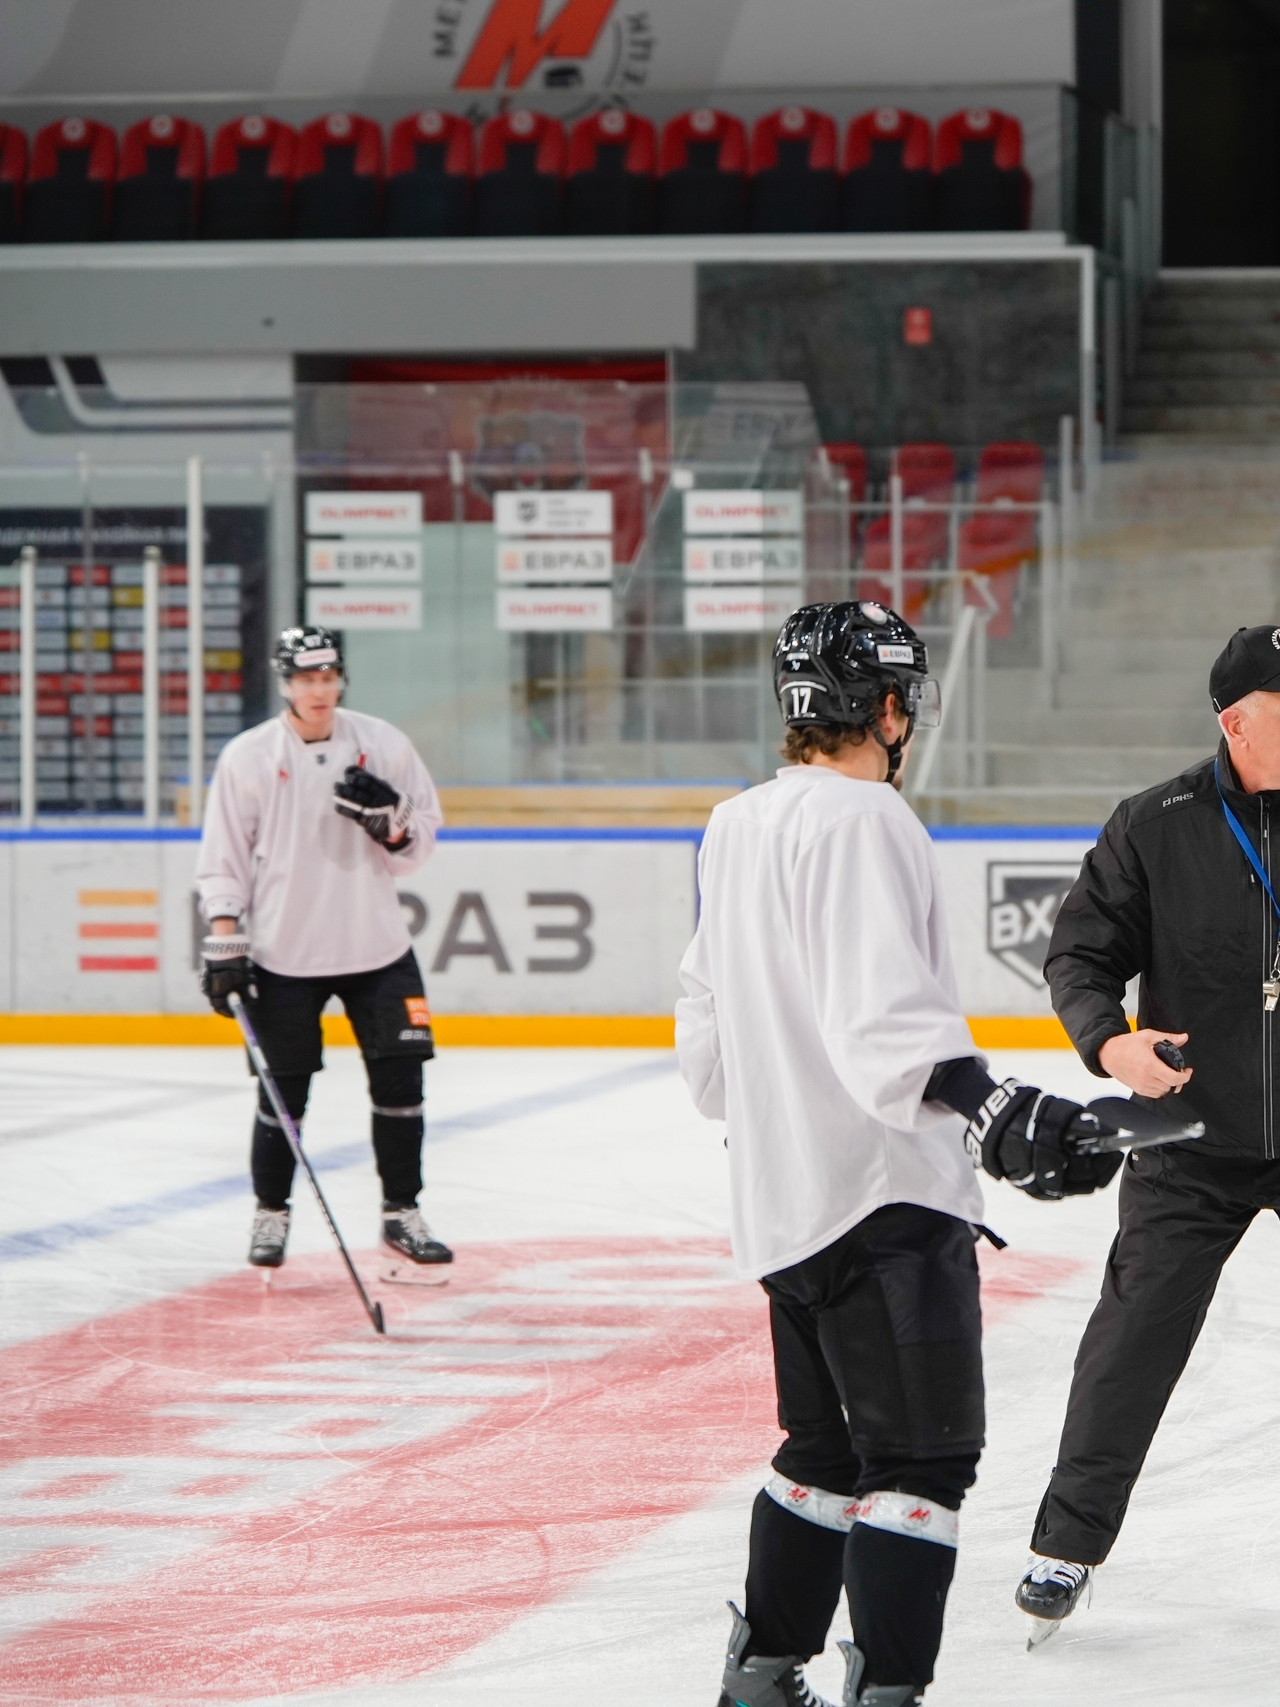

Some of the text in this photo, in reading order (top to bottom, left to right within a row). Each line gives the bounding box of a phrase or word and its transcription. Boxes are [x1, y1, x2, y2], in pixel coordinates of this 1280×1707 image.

[336, 551, 416, 570] ЕВРАЗ
[525, 551, 606, 570] ЕВРАЗ
[712, 550, 799, 569] ЕВРАЗ
[889, 649, 912, 659] ЕВРАЗ
[791, 687, 812, 714] 17
[991, 892, 1071, 948] ВХ
